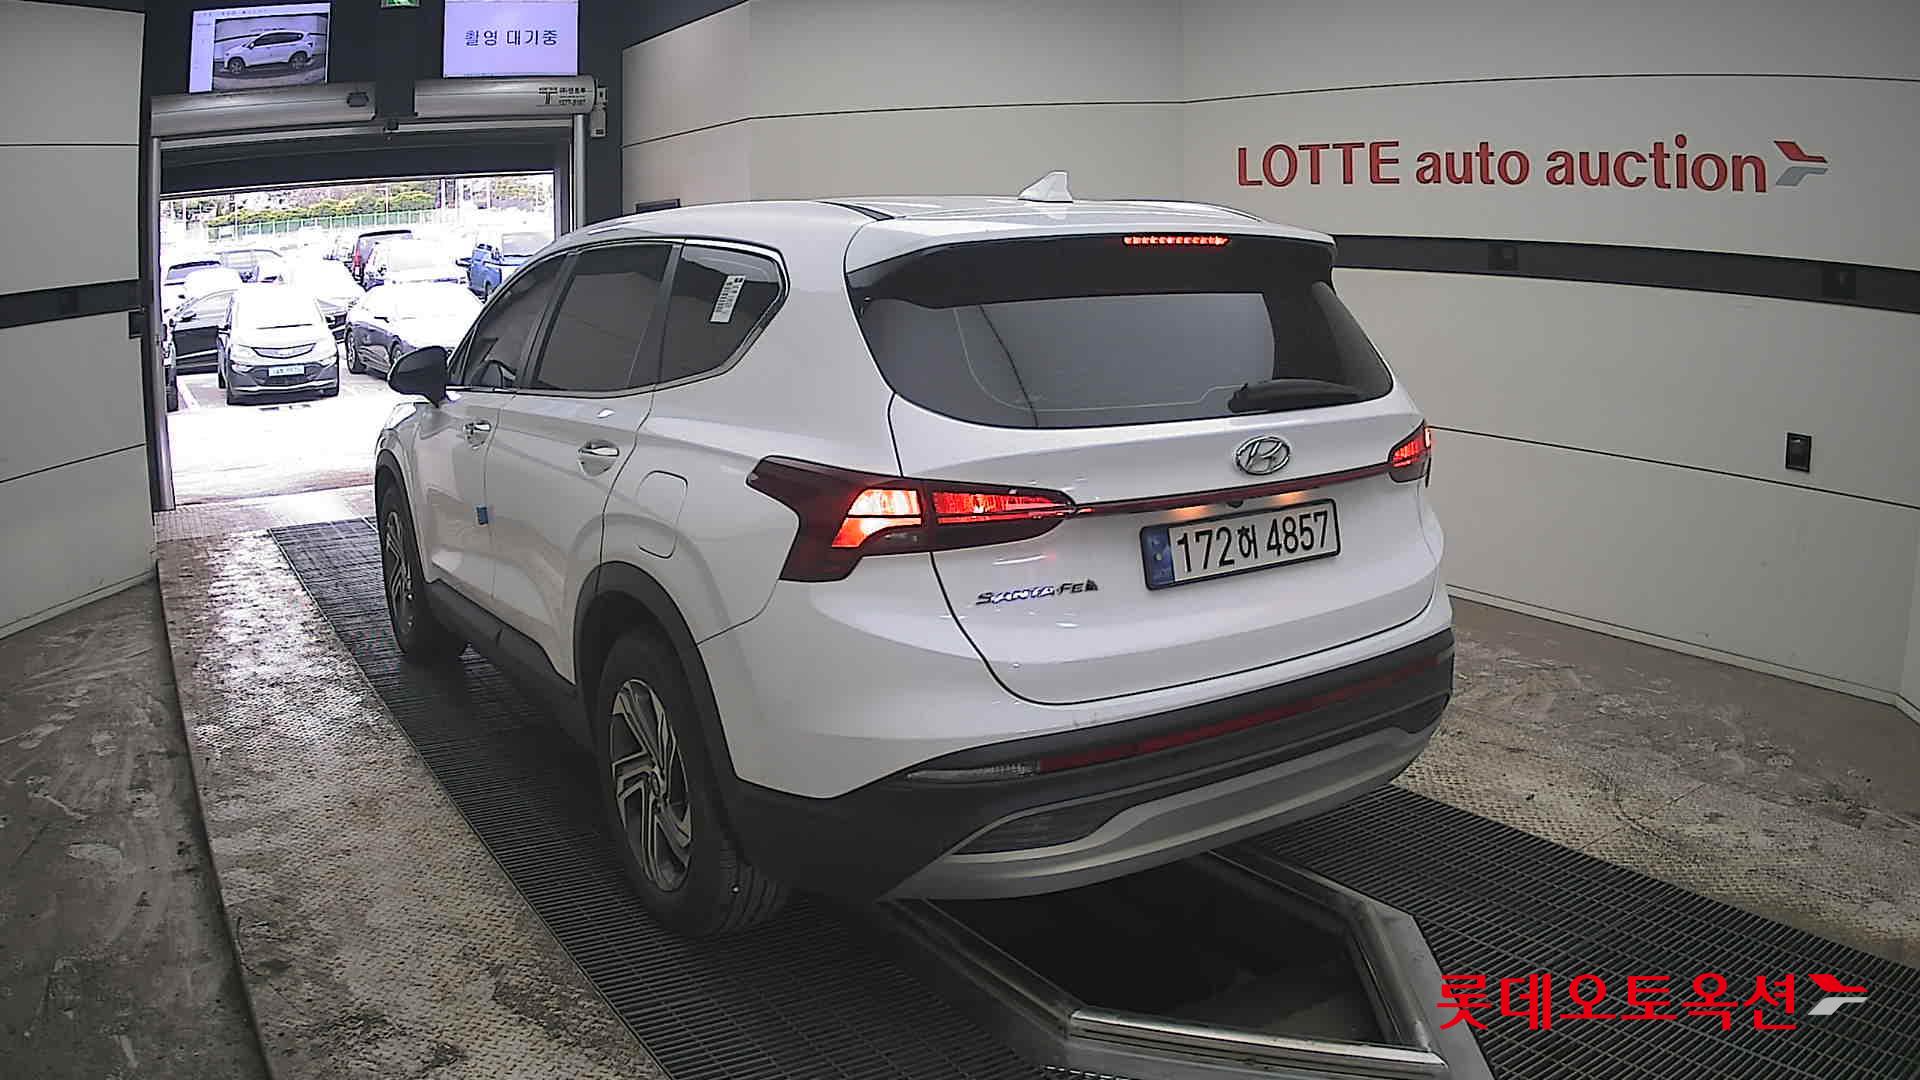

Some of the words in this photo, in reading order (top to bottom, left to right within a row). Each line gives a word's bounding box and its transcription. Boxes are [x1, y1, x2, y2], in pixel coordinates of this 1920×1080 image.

[465, 29, 498, 46] 촬영
[506, 29, 558, 46] 대기중
[1237, 140, 1400, 187] LOTTE
[1415, 141, 1530, 186] auto
[1544, 134, 1767, 193] auction
[1176, 523, 1258, 573] 172허
[1266, 510, 1328, 557] 4857
